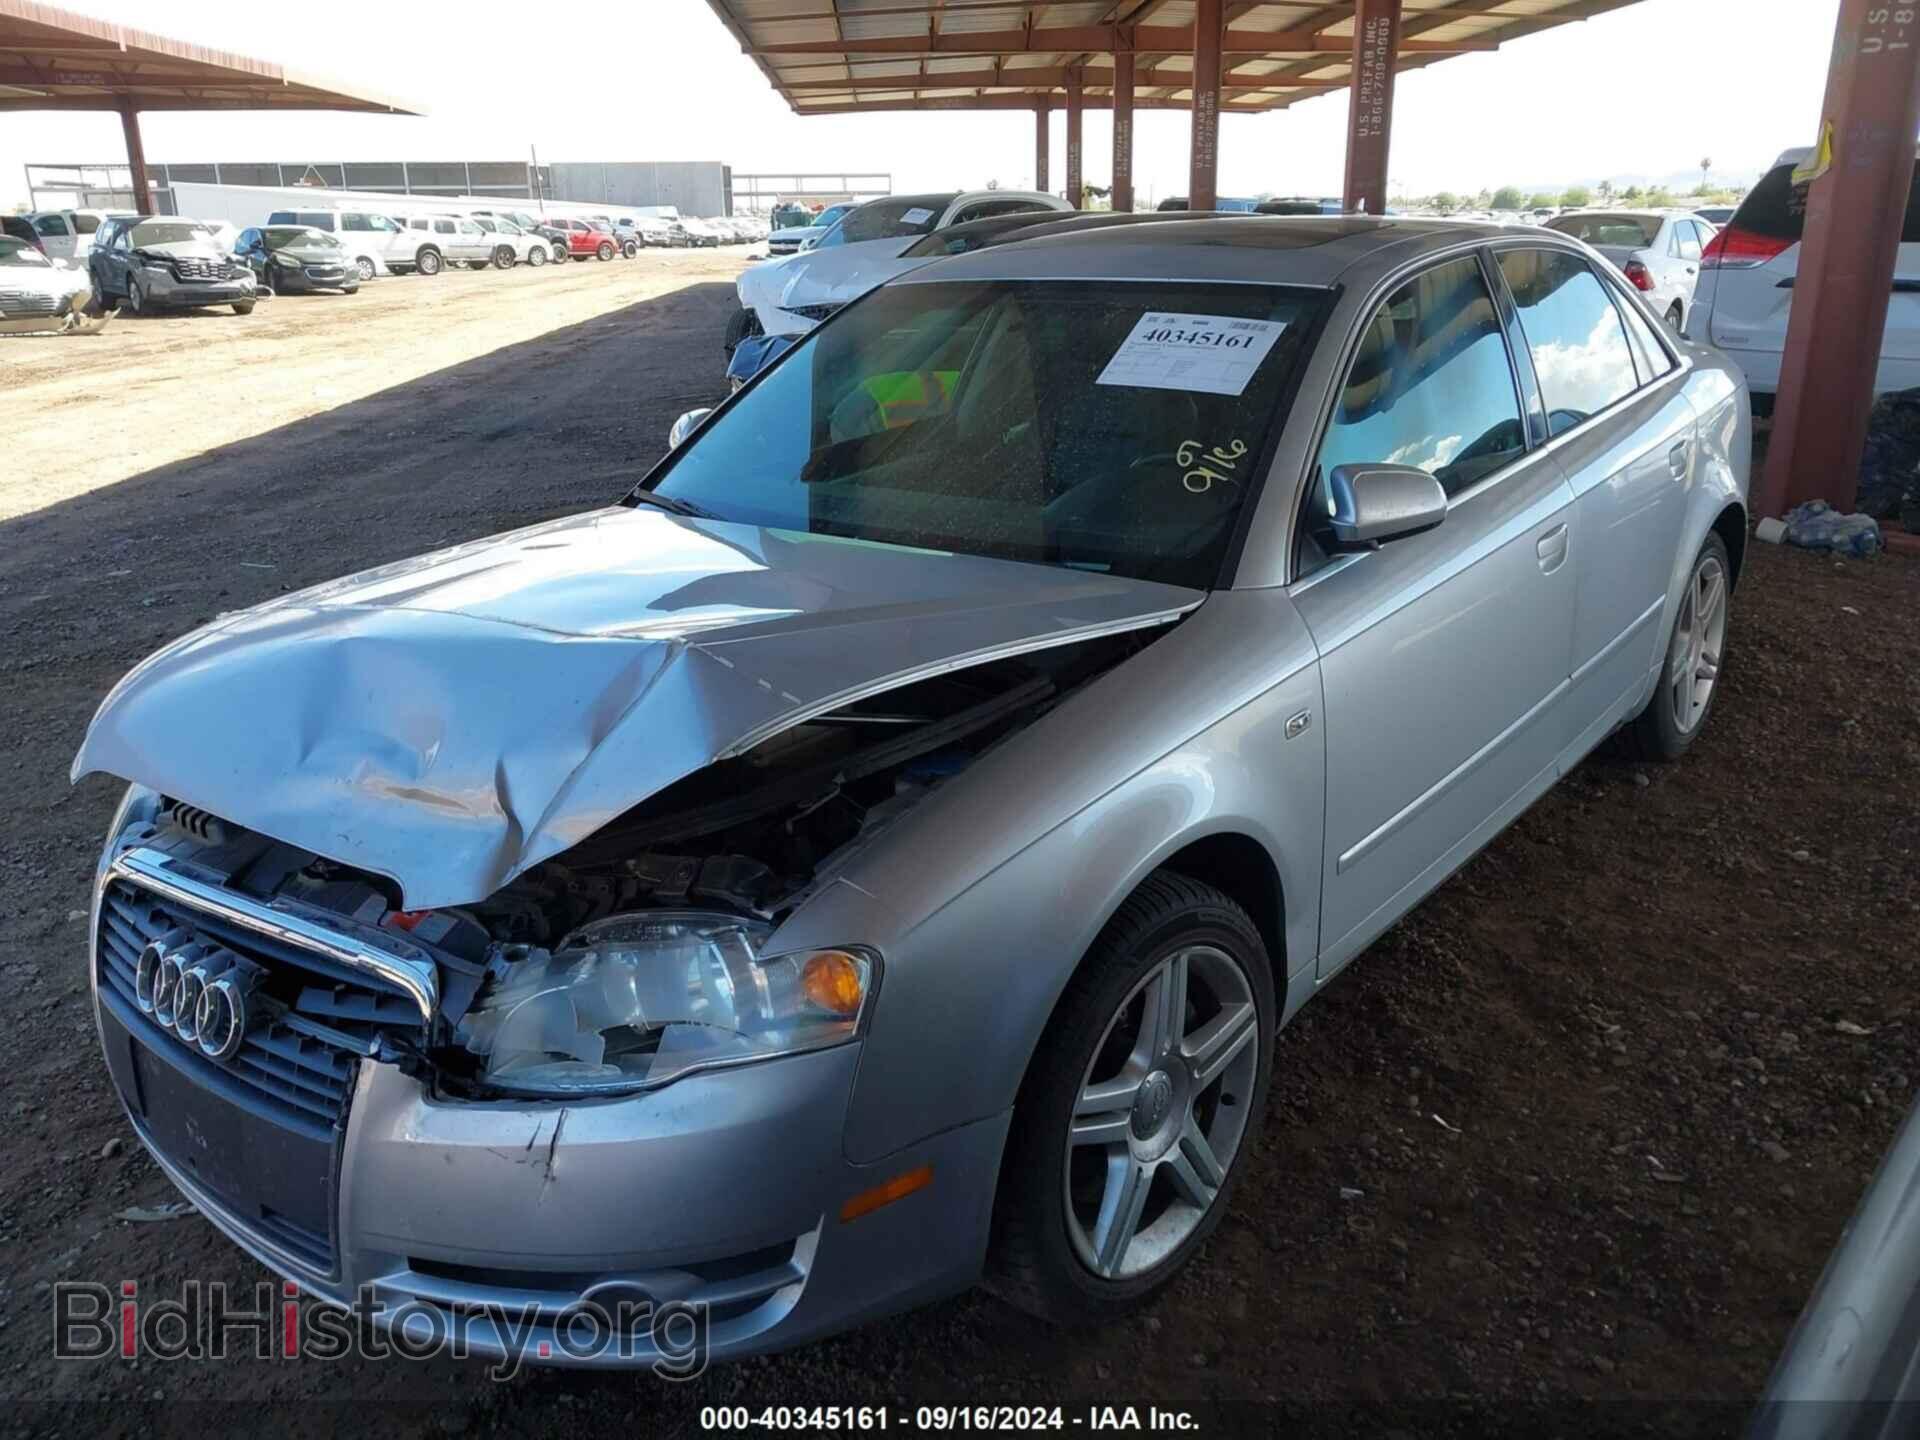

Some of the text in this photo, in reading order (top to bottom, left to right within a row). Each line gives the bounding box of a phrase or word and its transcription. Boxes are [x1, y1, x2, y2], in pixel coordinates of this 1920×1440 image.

[1365, 16, 1378, 44] INC.
[1360, 50, 1375, 104] PREFAB
[1142, 328, 1255, 349] 40345161
